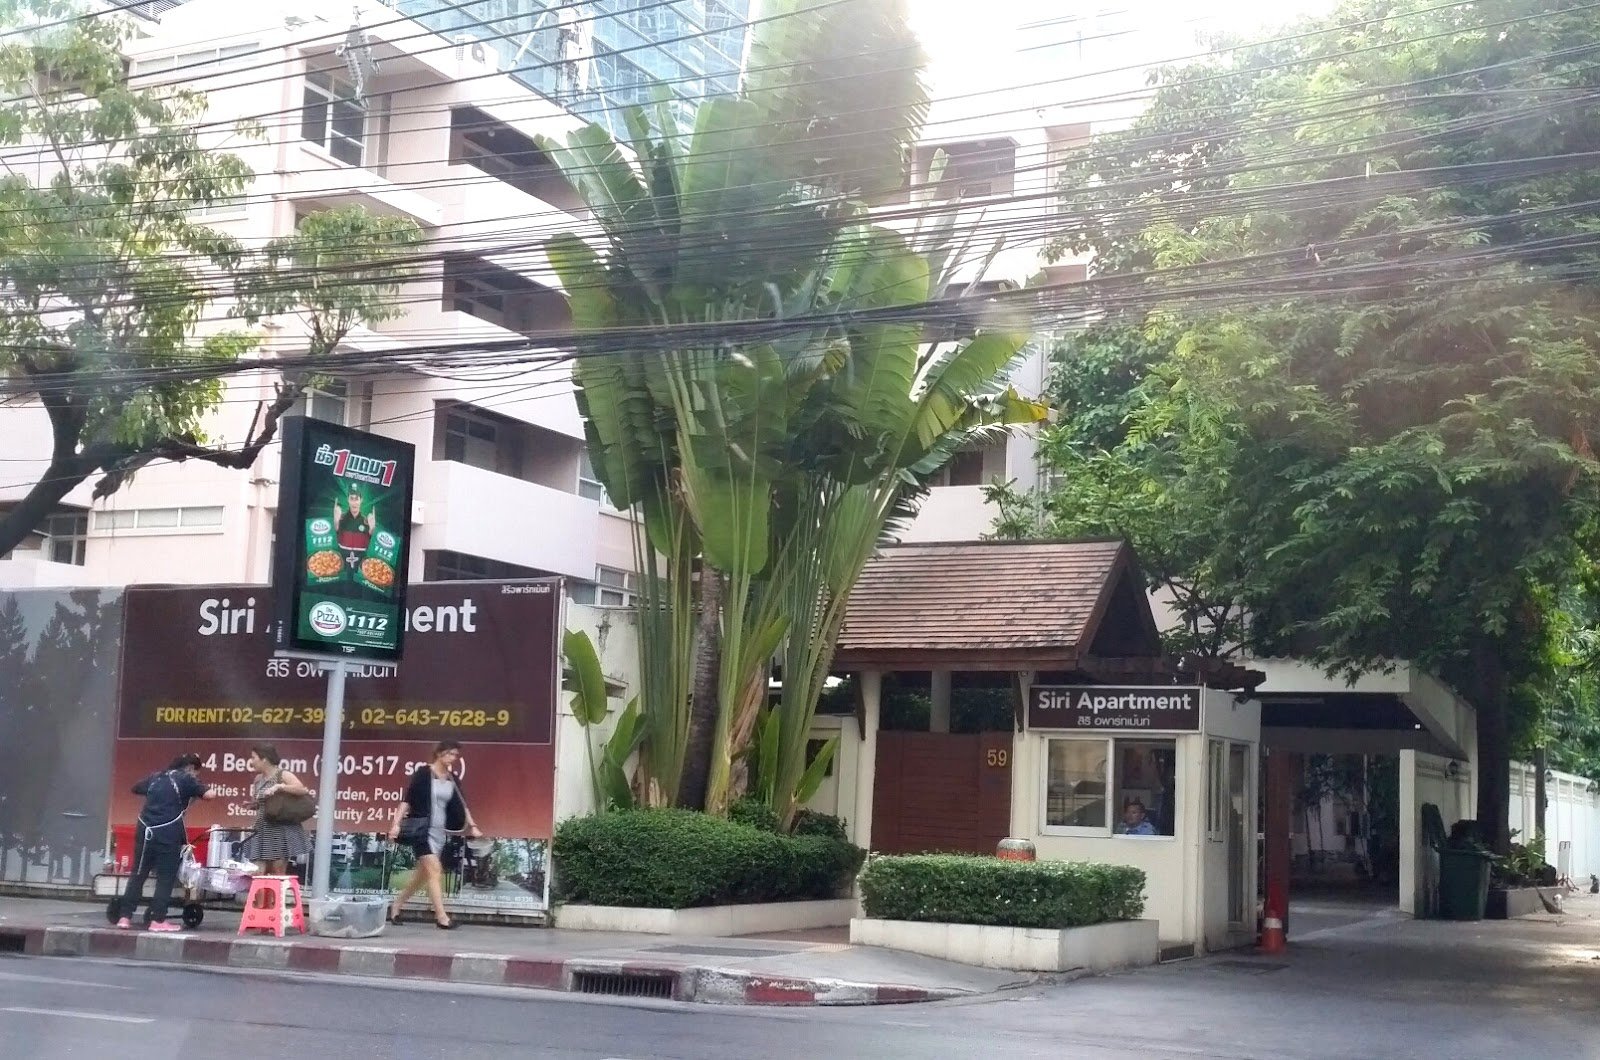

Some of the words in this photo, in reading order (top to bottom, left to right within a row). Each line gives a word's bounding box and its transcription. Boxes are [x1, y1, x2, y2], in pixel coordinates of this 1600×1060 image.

[198, 596, 256, 637] Siri
[316, 610, 340, 623] PIZZA
[347, 614, 388, 631] 1112
[1038, 690, 1071, 710] Siri
[1076, 691, 1192, 715] Apartment
[155, 706, 186, 723] FOR
[361, 708, 510, 728] 02-643-7628-9
[987, 749, 1008, 767] 59
[367, 807, 383, 822] 24
